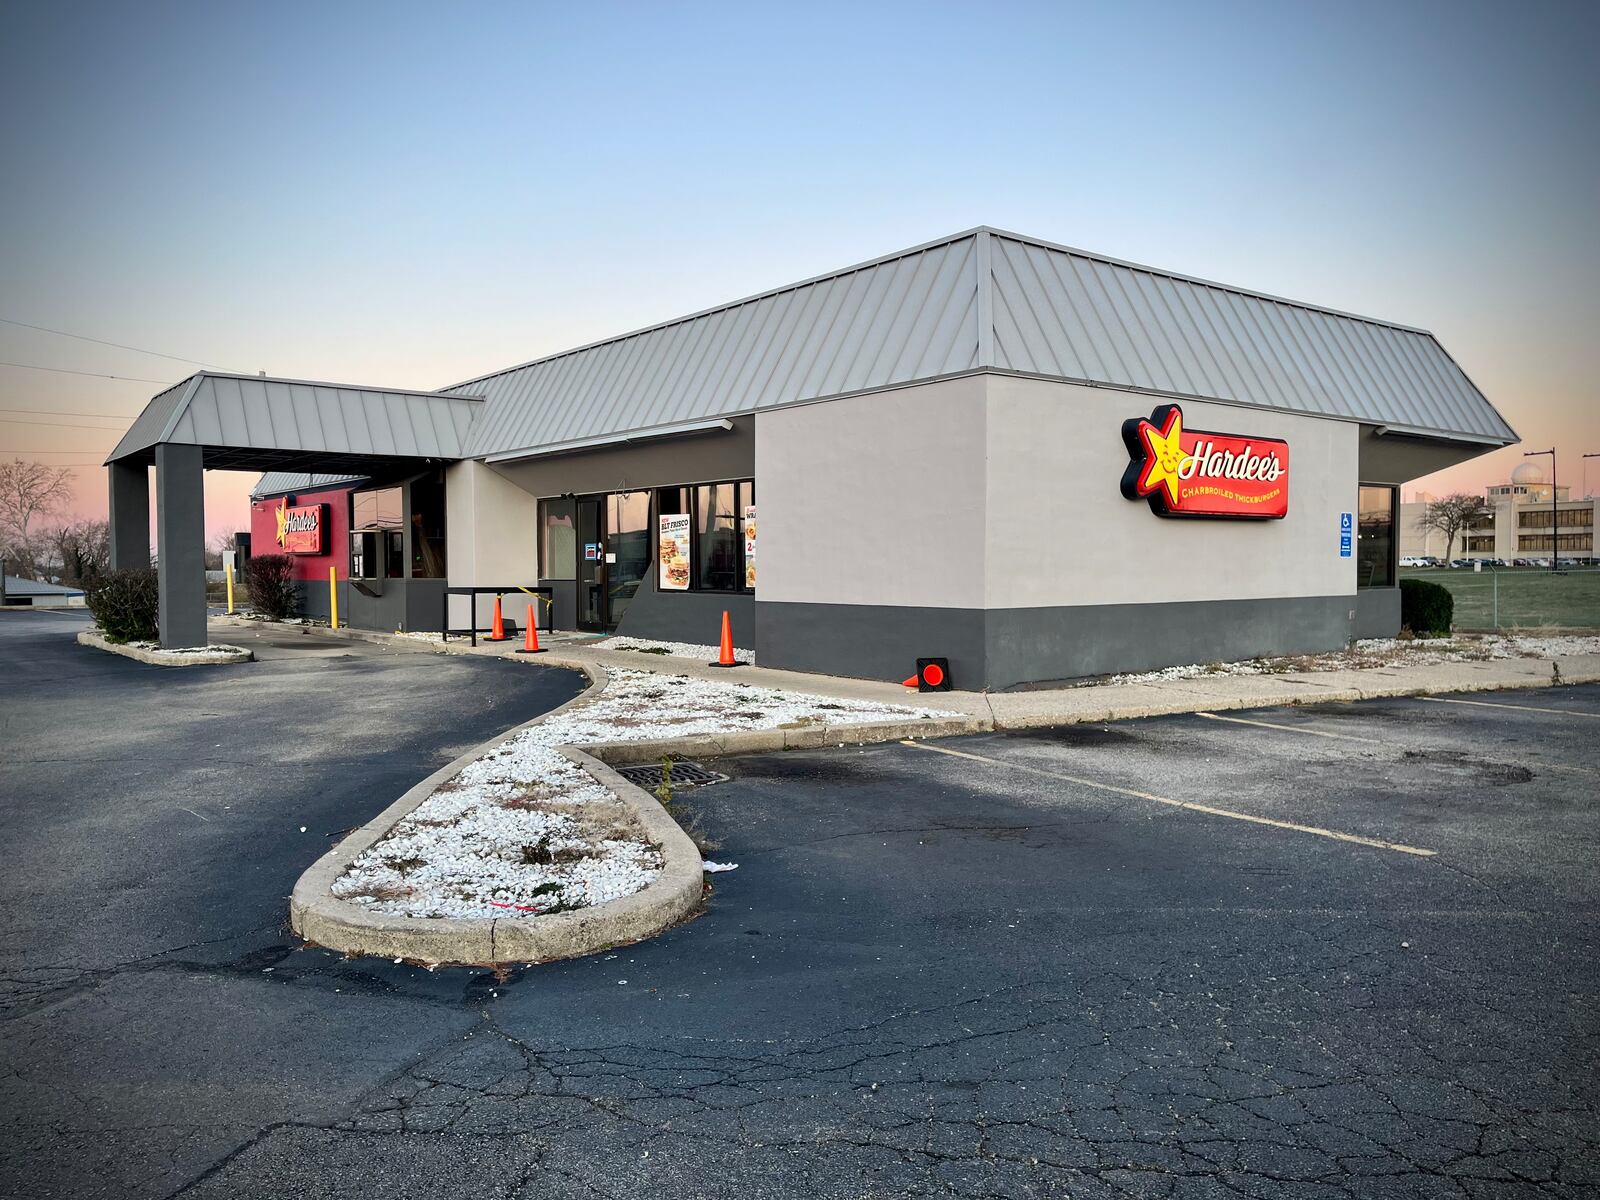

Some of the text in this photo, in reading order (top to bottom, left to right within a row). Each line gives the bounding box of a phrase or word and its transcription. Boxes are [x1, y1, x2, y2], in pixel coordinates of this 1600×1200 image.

[1177, 441, 1286, 482] Hardee's
[1181, 486, 1281, 504] CHARBROILED THICKBURGERS
[284, 511, 318, 535] Hardee's
[661, 523, 670, 531] BLT
[670, 519, 689, 529] FRISCO
